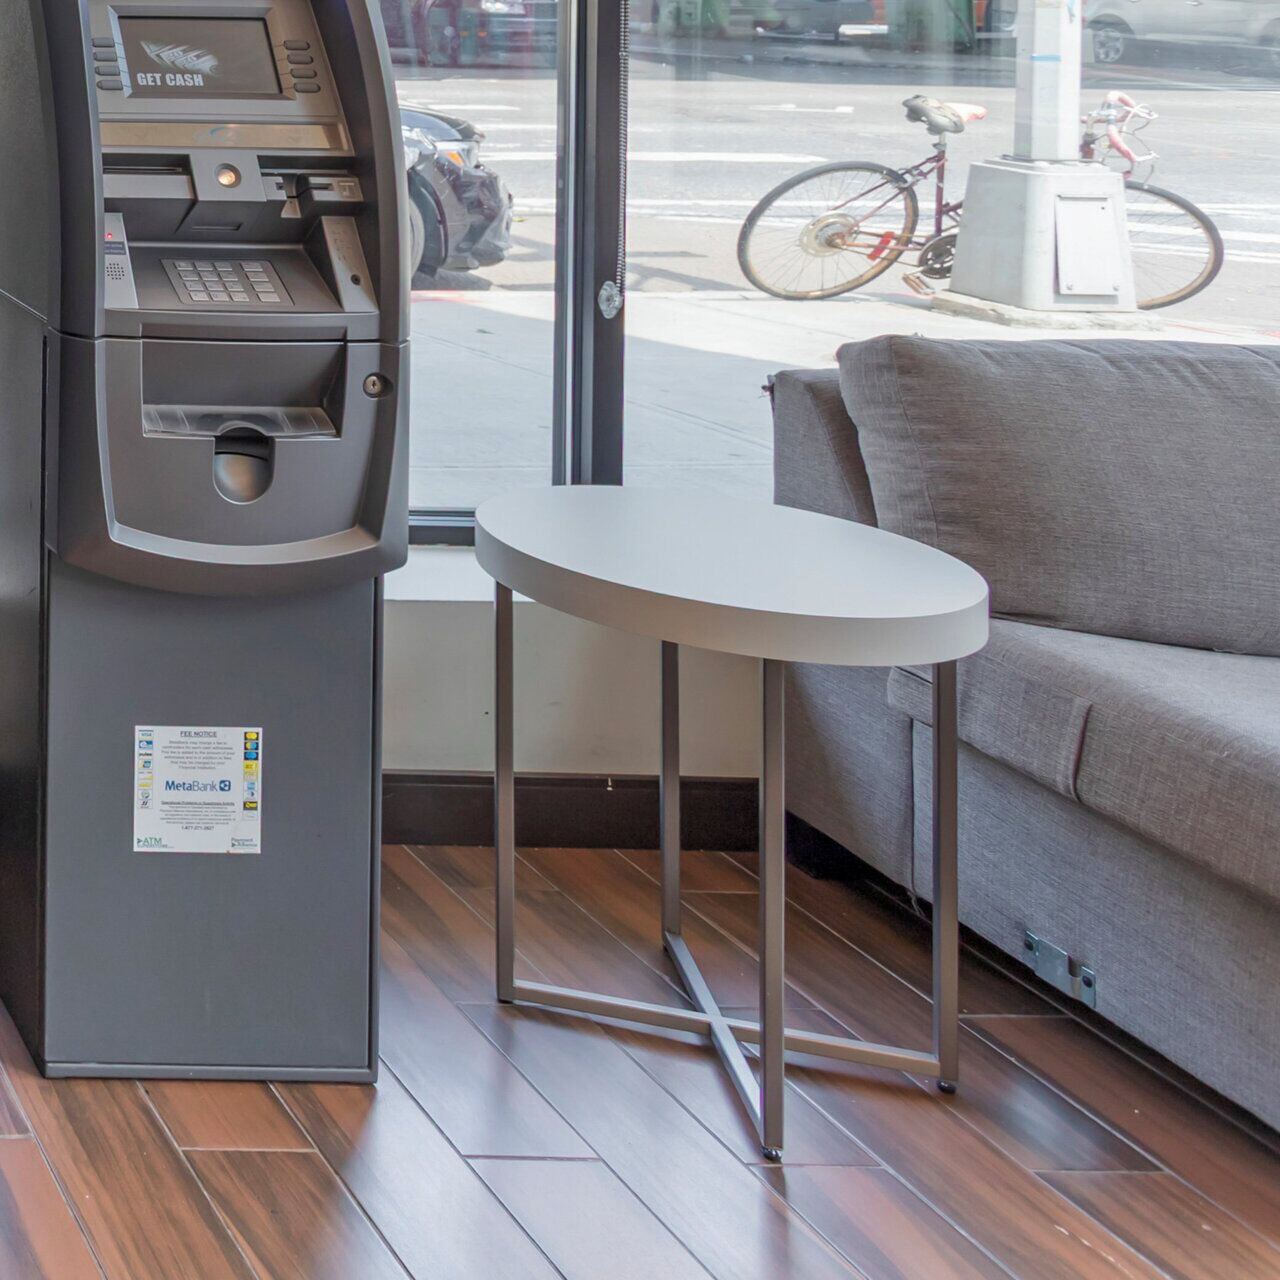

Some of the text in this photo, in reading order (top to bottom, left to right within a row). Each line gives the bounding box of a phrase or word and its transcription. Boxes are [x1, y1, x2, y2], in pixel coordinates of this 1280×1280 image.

[137, 73, 204, 87] GET CASH
[165, 780, 218, 792] MetaBank
[143, 837, 162, 845] ATM
